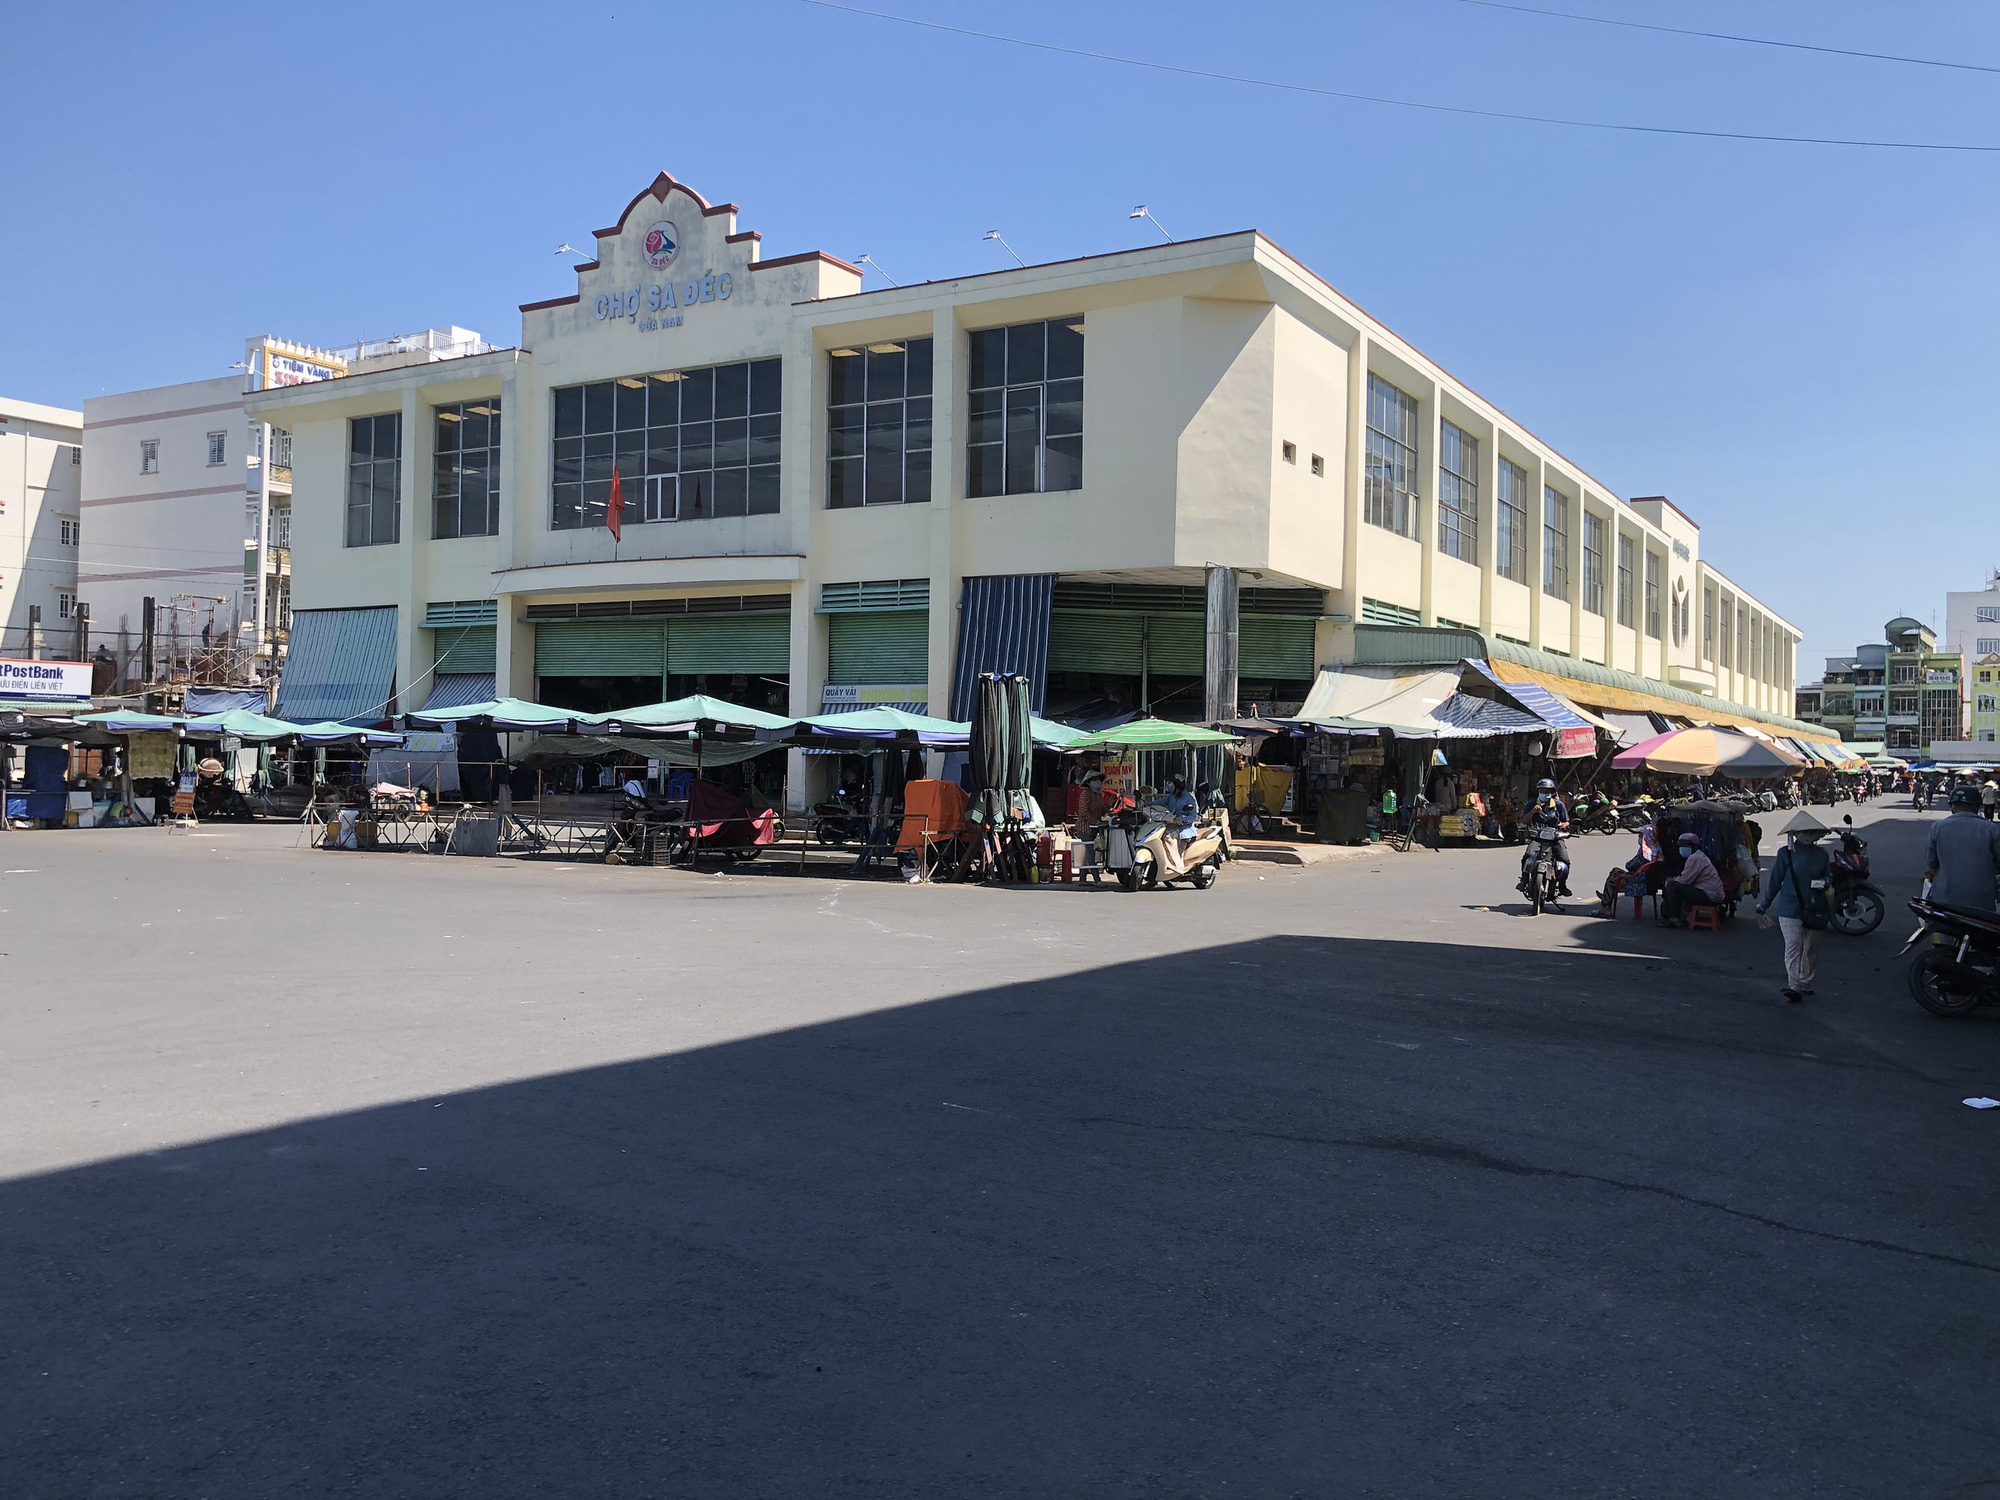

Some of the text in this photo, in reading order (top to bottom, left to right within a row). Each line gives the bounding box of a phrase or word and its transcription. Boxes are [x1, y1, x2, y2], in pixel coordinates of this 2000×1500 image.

[593, 268, 733, 324] CHỢ SA ĐÉC
[661, 314, 684, 329] NAM
[307, 365, 331, 380] VÀNG
[30, 680, 47, 690] LIÊN
